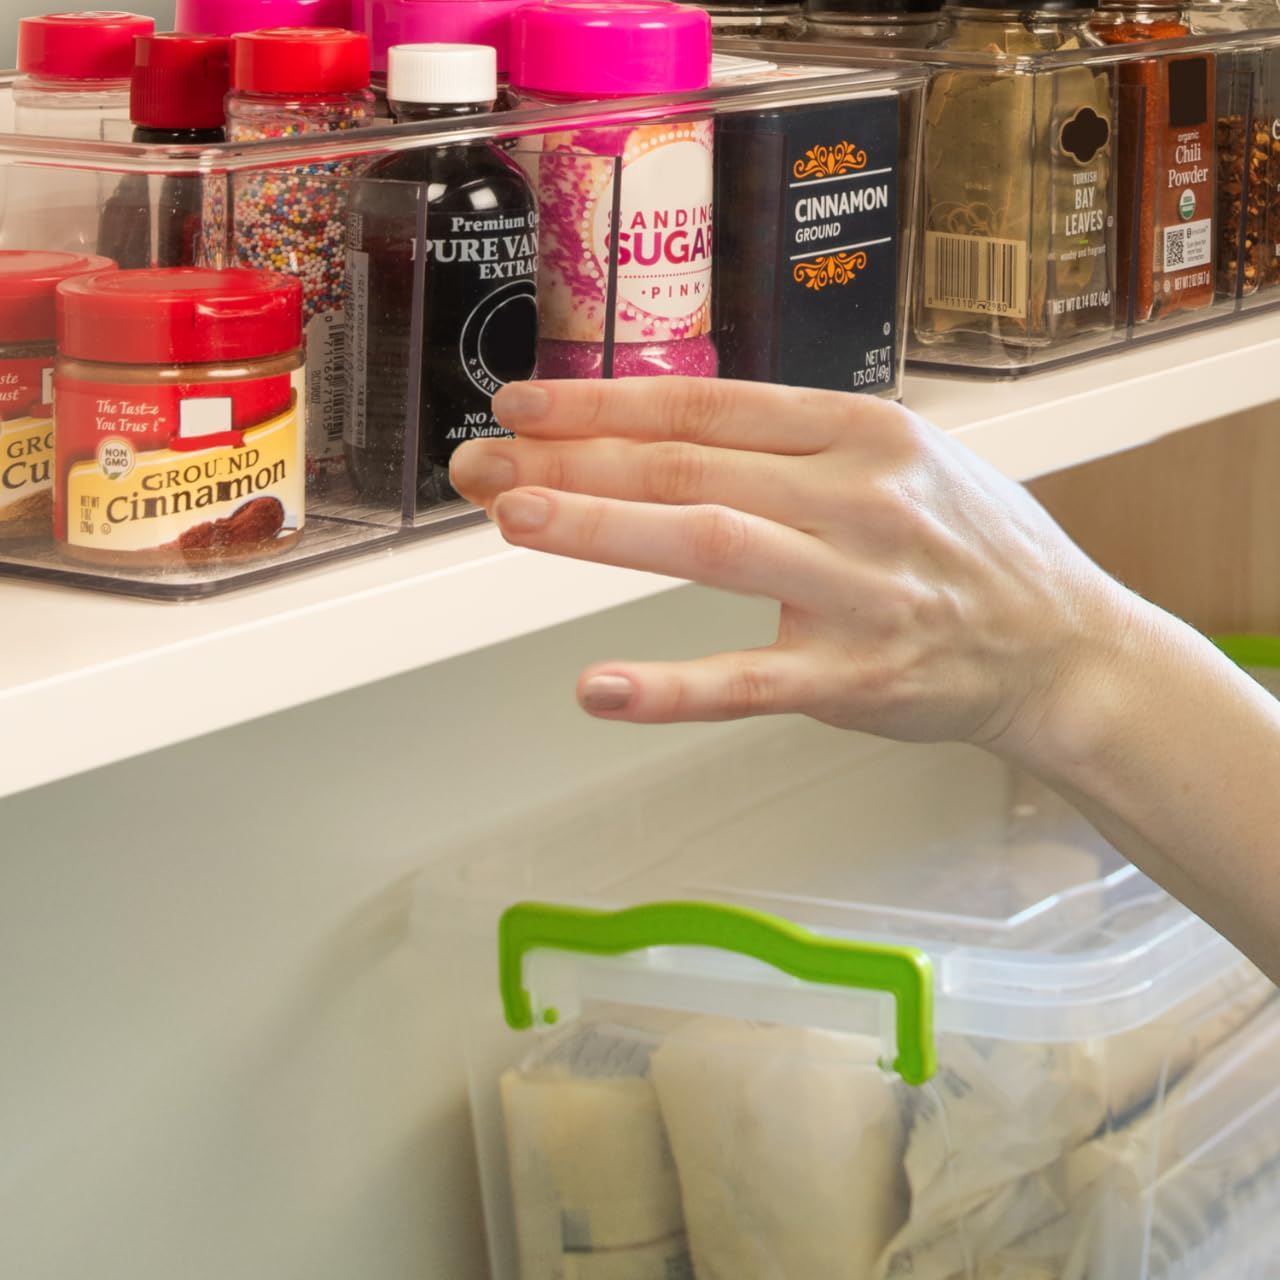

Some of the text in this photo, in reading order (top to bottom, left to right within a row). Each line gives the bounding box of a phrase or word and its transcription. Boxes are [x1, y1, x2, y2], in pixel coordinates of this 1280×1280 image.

[1175, 142, 1202, 165] Chili
[1072, 170, 1098, 186] TURKISH
[1167, 164, 1209, 188] Powder
[794, 184, 888, 223] CINNAMON
[1074, 186, 1096, 210] BAY
[450, 215, 525, 233] Premium
[794, 222, 842, 244] GROUND
[1065, 209, 1104, 237] LEAVES
[603, 224, 713, 267] SUGAR
[865, 345, 892, 367] NET WT
[865, 366, 876, 384] OZ
[96, 399, 117, 414] The
[96, 416, 117, 432] You
[463, 412, 488, 425] NO
[445, 426, 467, 439] All
[104, 449, 128, 458] NON
[104, 458, 129, 468] GMO
[141, 448, 260, 491] GROUND
[106, 457, 287, 524] Cinnamon
